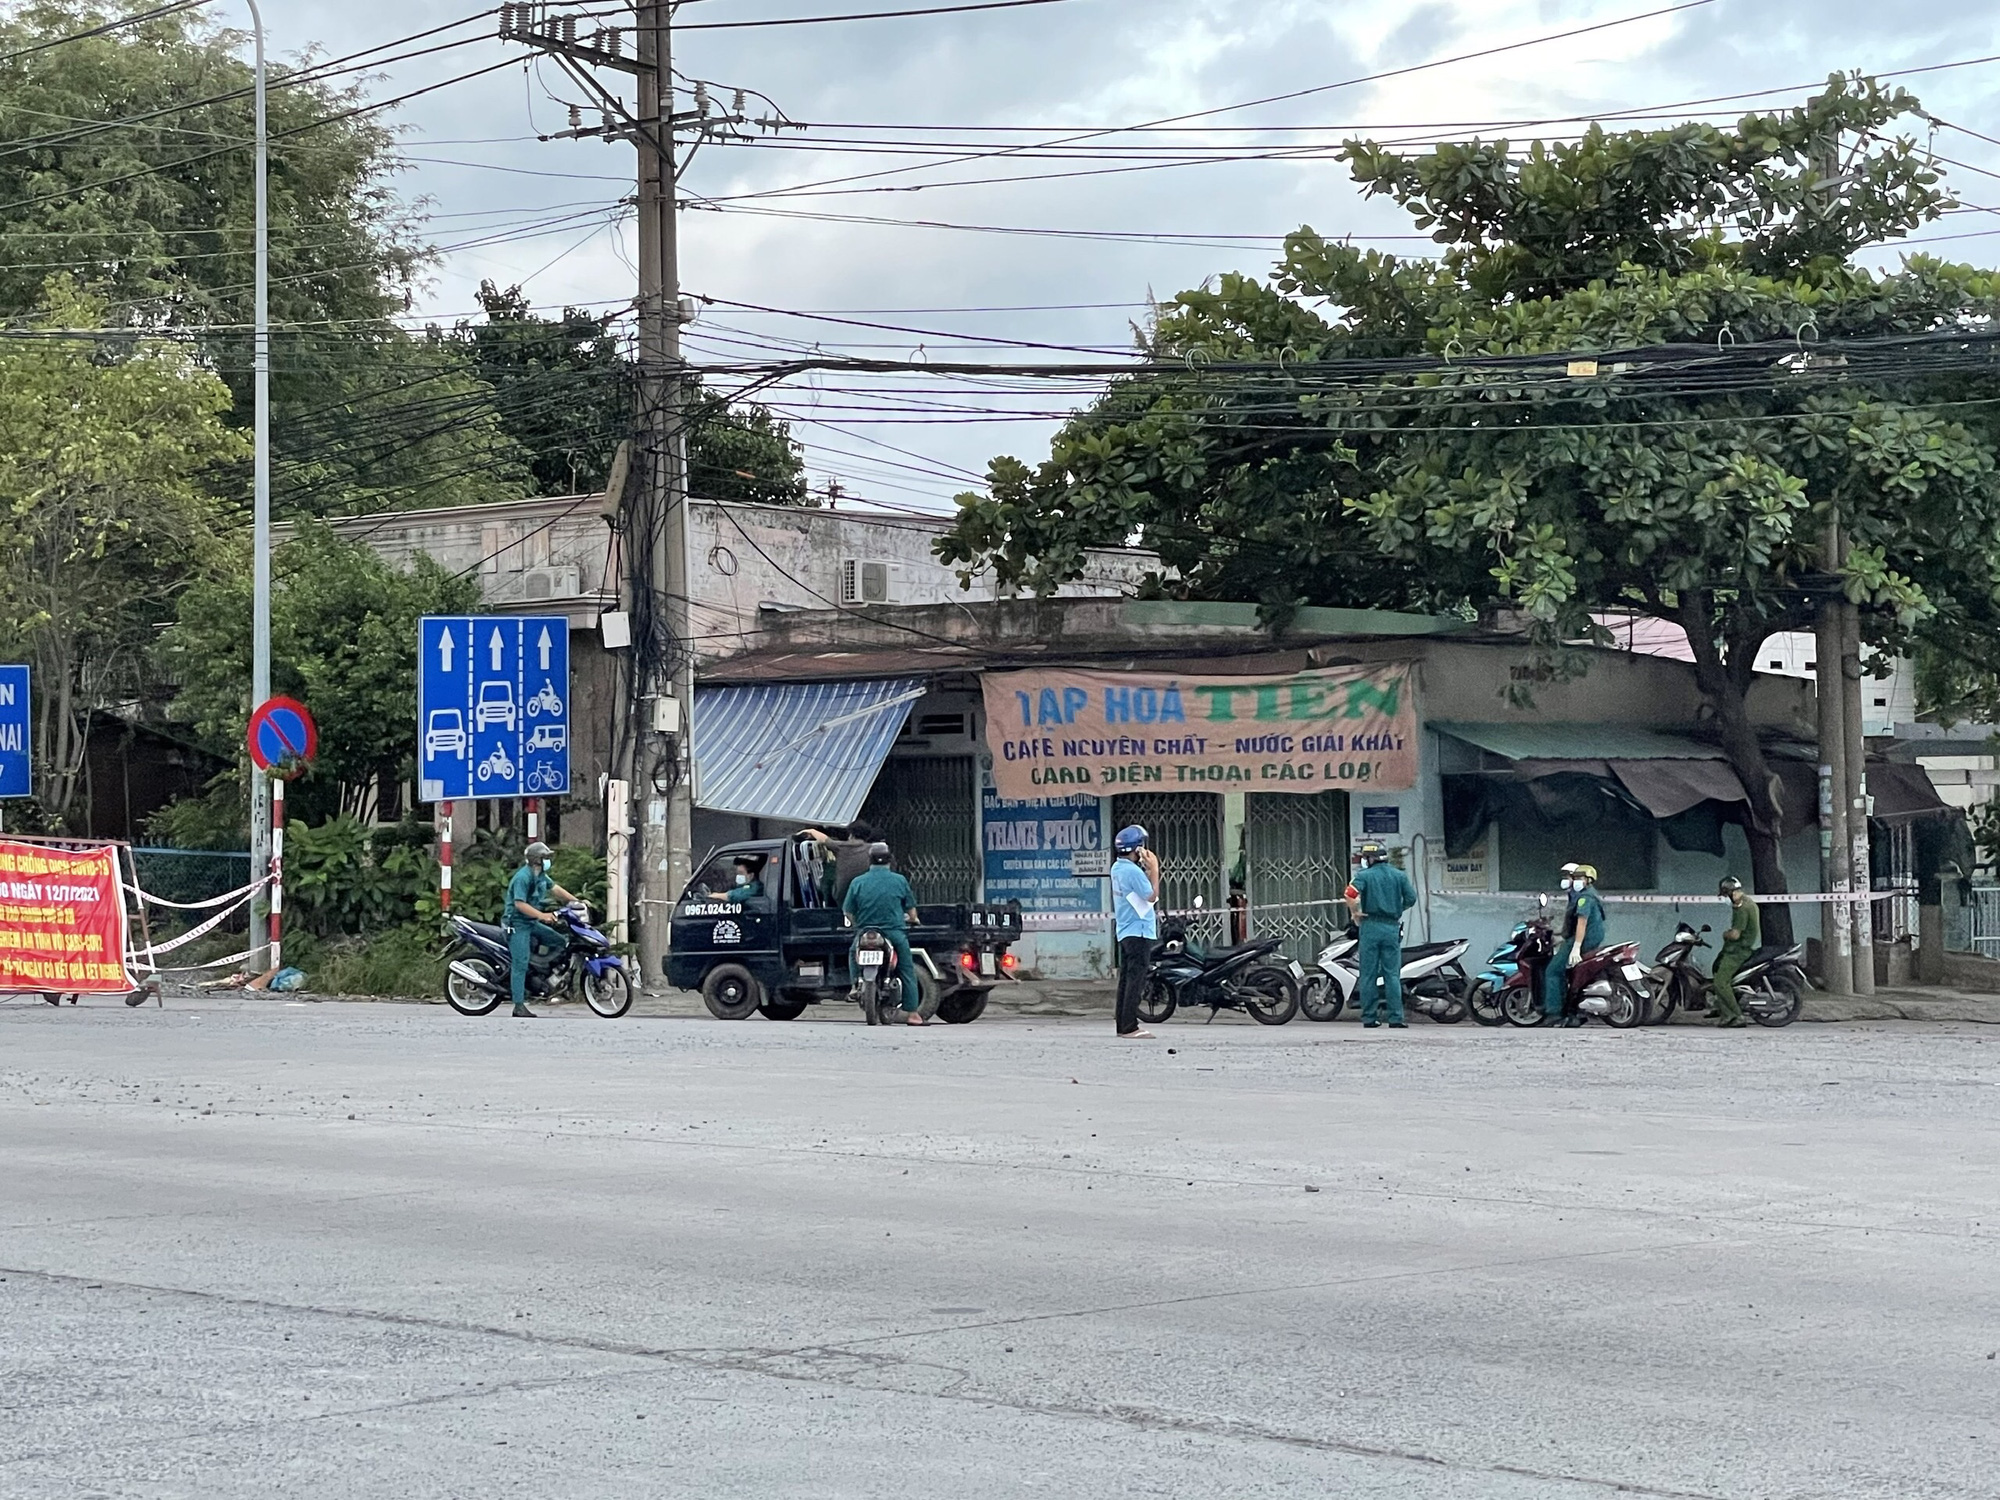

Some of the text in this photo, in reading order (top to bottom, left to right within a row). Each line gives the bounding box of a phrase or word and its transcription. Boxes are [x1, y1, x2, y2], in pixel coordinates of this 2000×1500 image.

[1235, 732, 1294, 753] NƯỚC
[1301, 729, 1344, 752] GIẢI
[1261, 758, 1315, 781] CÁC
[985, 811, 1098, 851] THANH PHÚC
[10, 880, 42, 900] NGÀY
[45, 885, 99, 901] 12/7/2021
[685, 903, 742, 916] 0967.024.210
